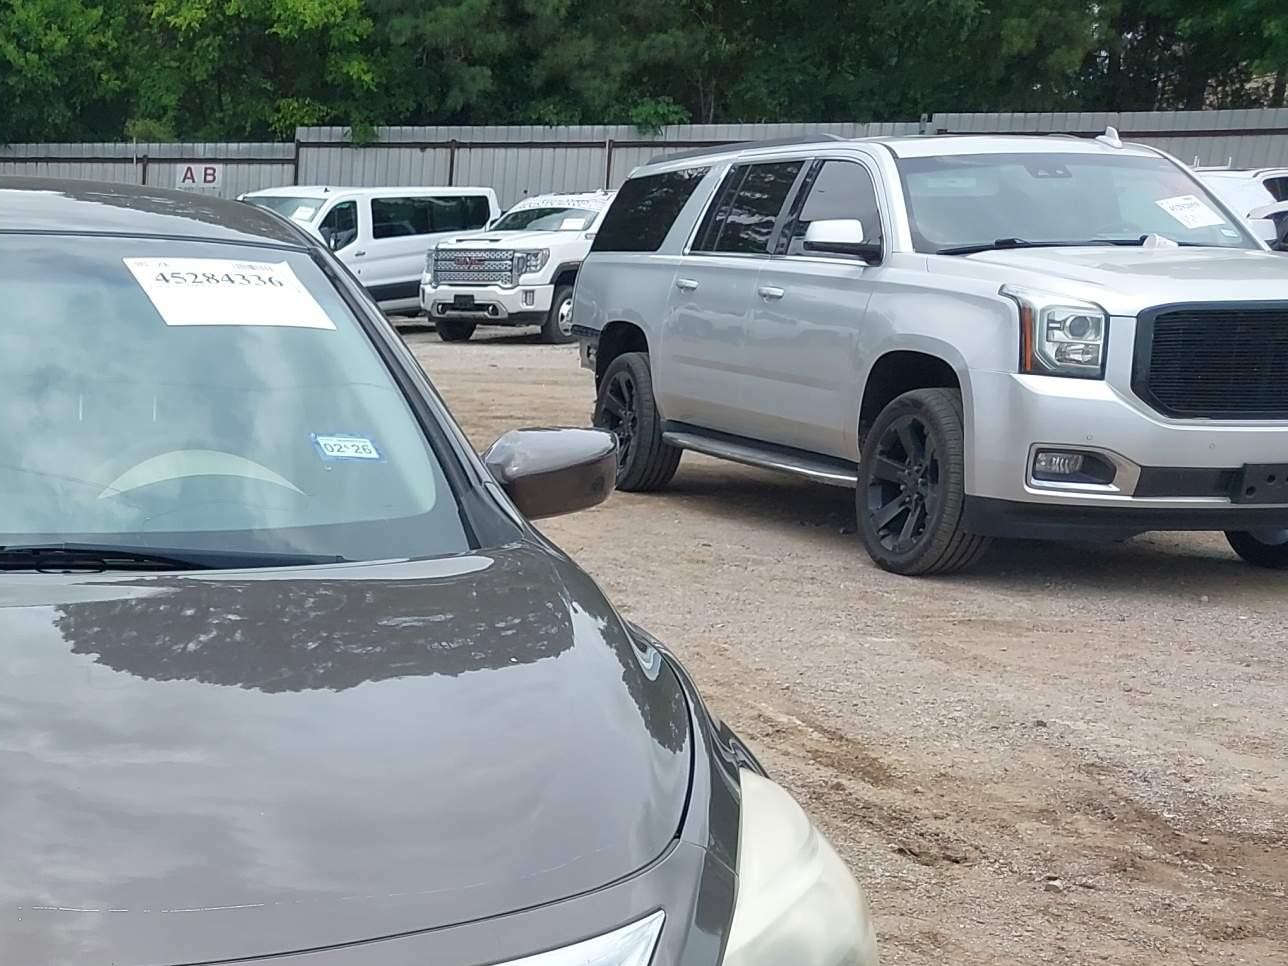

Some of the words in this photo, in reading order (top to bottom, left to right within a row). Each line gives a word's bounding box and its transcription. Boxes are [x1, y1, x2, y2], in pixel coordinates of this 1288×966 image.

[182, 166, 196, 183] A
[203, 166, 217, 183] B
[155, 272, 284, 288] 45284336
